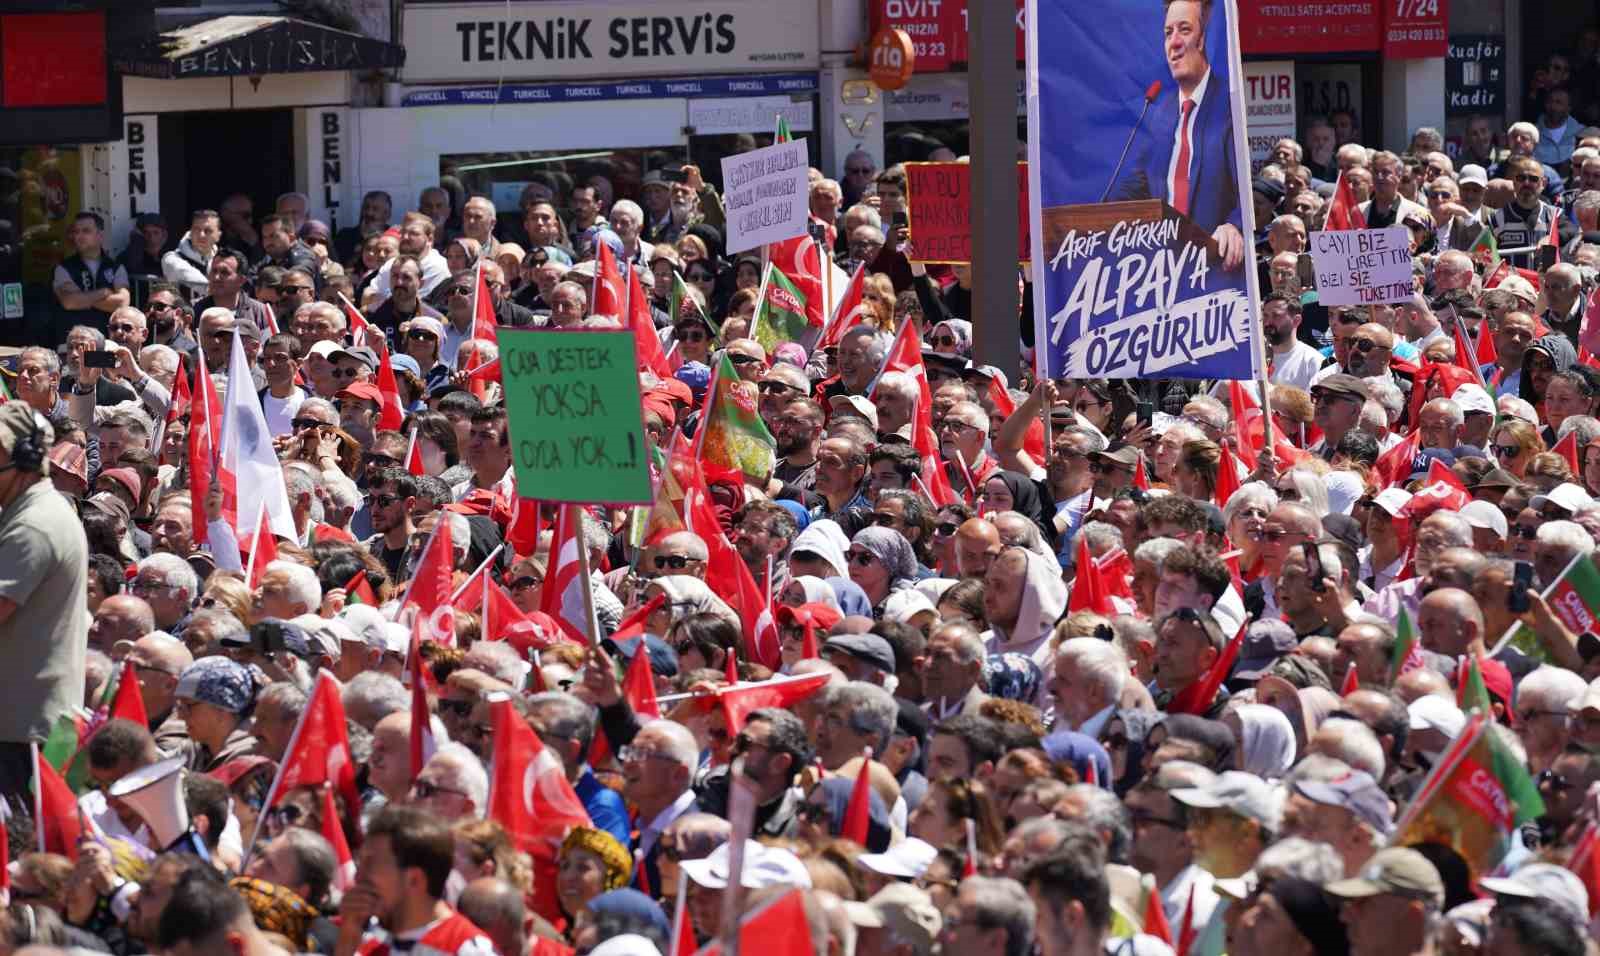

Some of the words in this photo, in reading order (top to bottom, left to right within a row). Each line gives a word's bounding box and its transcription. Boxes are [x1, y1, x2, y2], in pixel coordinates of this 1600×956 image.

[1395, 0, 1439, 18] 7/24
[873, 37, 903, 68] ria
[565, 87, 602, 97] TURKCELL
[615, 84, 652, 94] TURKCELL
[666, 82, 703, 93] TURKCELL
[728, 81, 765, 91] TURKCELL
[777, 79, 815, 89] TURKCELL
[1246, 74, 1292, 101] TUR
[409, 91, 447, 102] TURKCELL
[460, 90, 499, 101] TURKCELL
[513, 89, 551, 99] TURKCELL
[1451, 89, 1496, 106] Kadir
[936, 170, 961, 199] BU
[1107, 217, 1182, 256] GÜRKAN
[1085, 297, 1239, 376] ÖZGÜRLÜK
[547, 345, 614, 375] DESTEK
[530, 380, 608, 420] YOKSA
